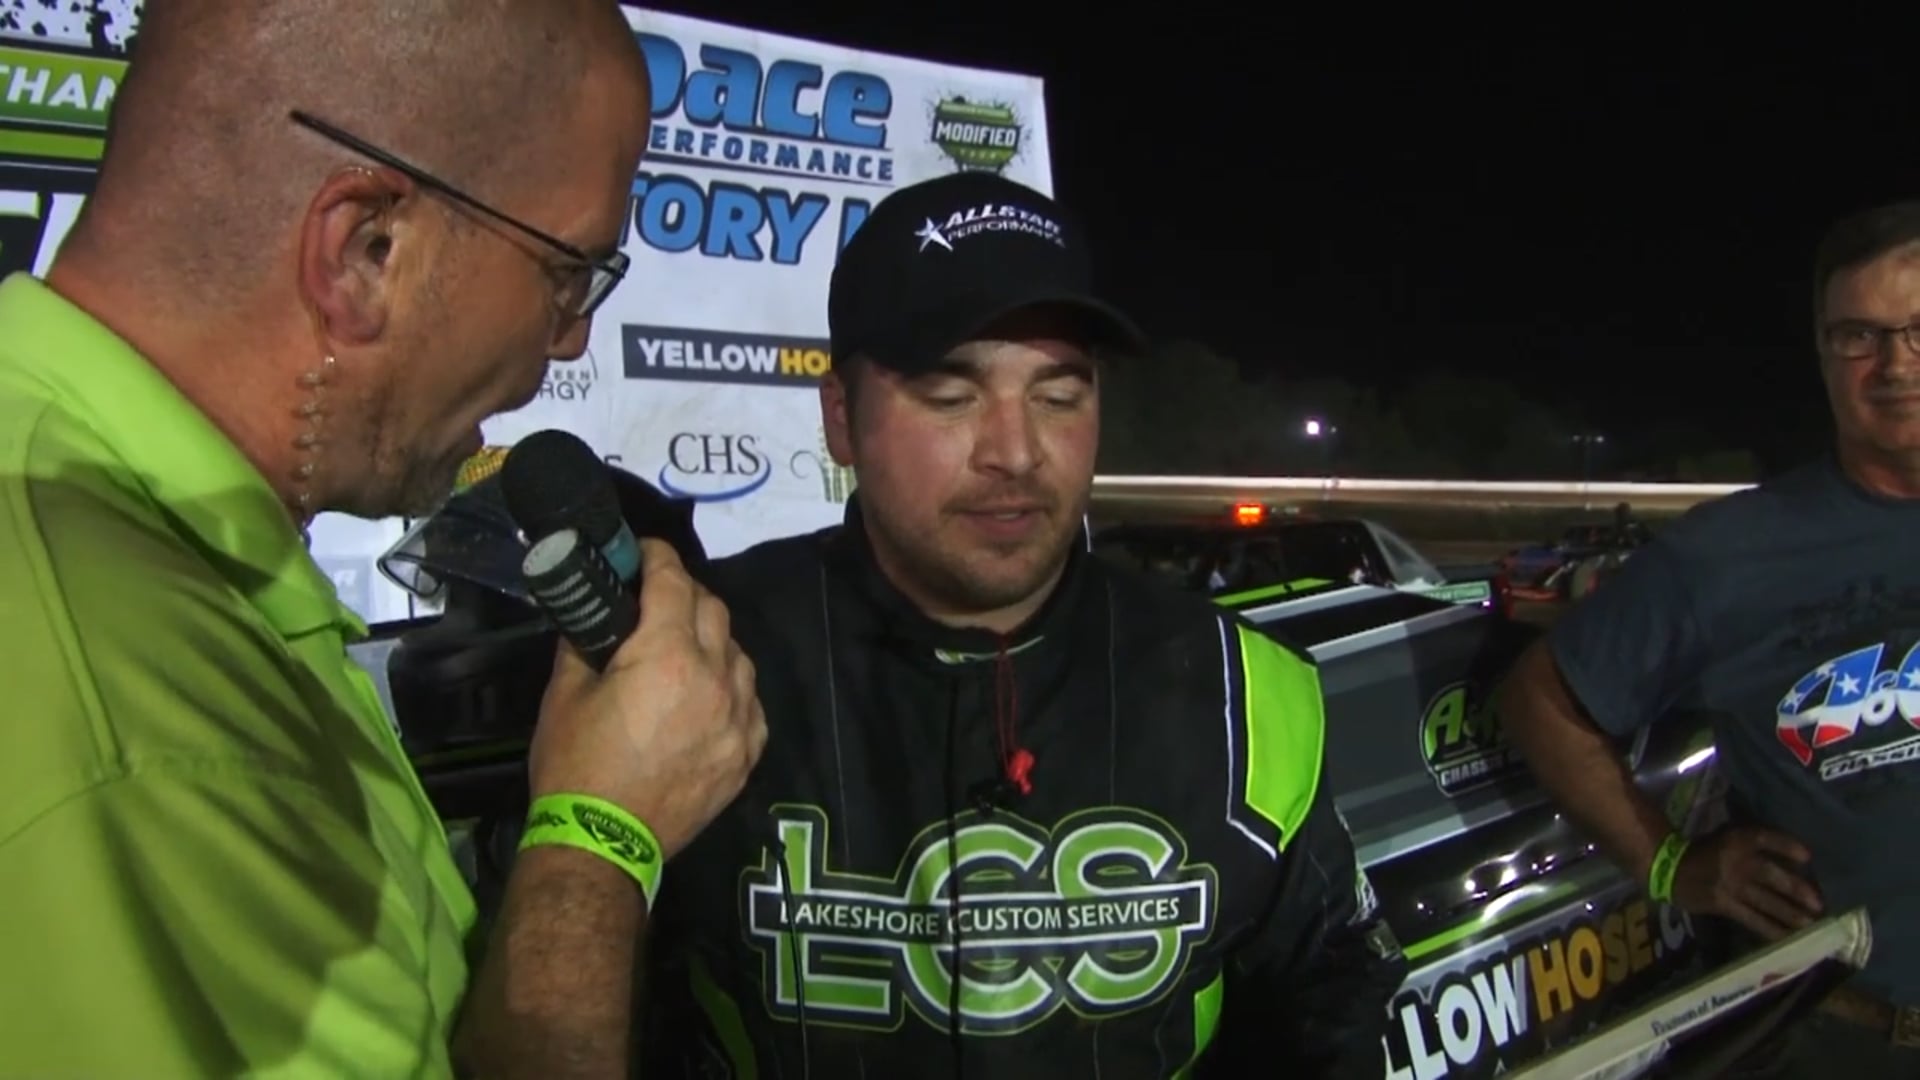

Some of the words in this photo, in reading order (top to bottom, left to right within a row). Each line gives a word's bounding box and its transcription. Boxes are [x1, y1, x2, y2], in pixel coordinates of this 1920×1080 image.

[935, 121, 1017, 148] MODIFIED
[944, 203, 1060, 234] ALLSTAR
[638, 337, 831, 377] YELLOWHO
[668, 432, 760, 477] CHS
[780, 900, 940, 936] LAKESHORE
[947, 899, 1062, 935] CUSTOM
[1067, 896, 1180, 929] SERVICES
